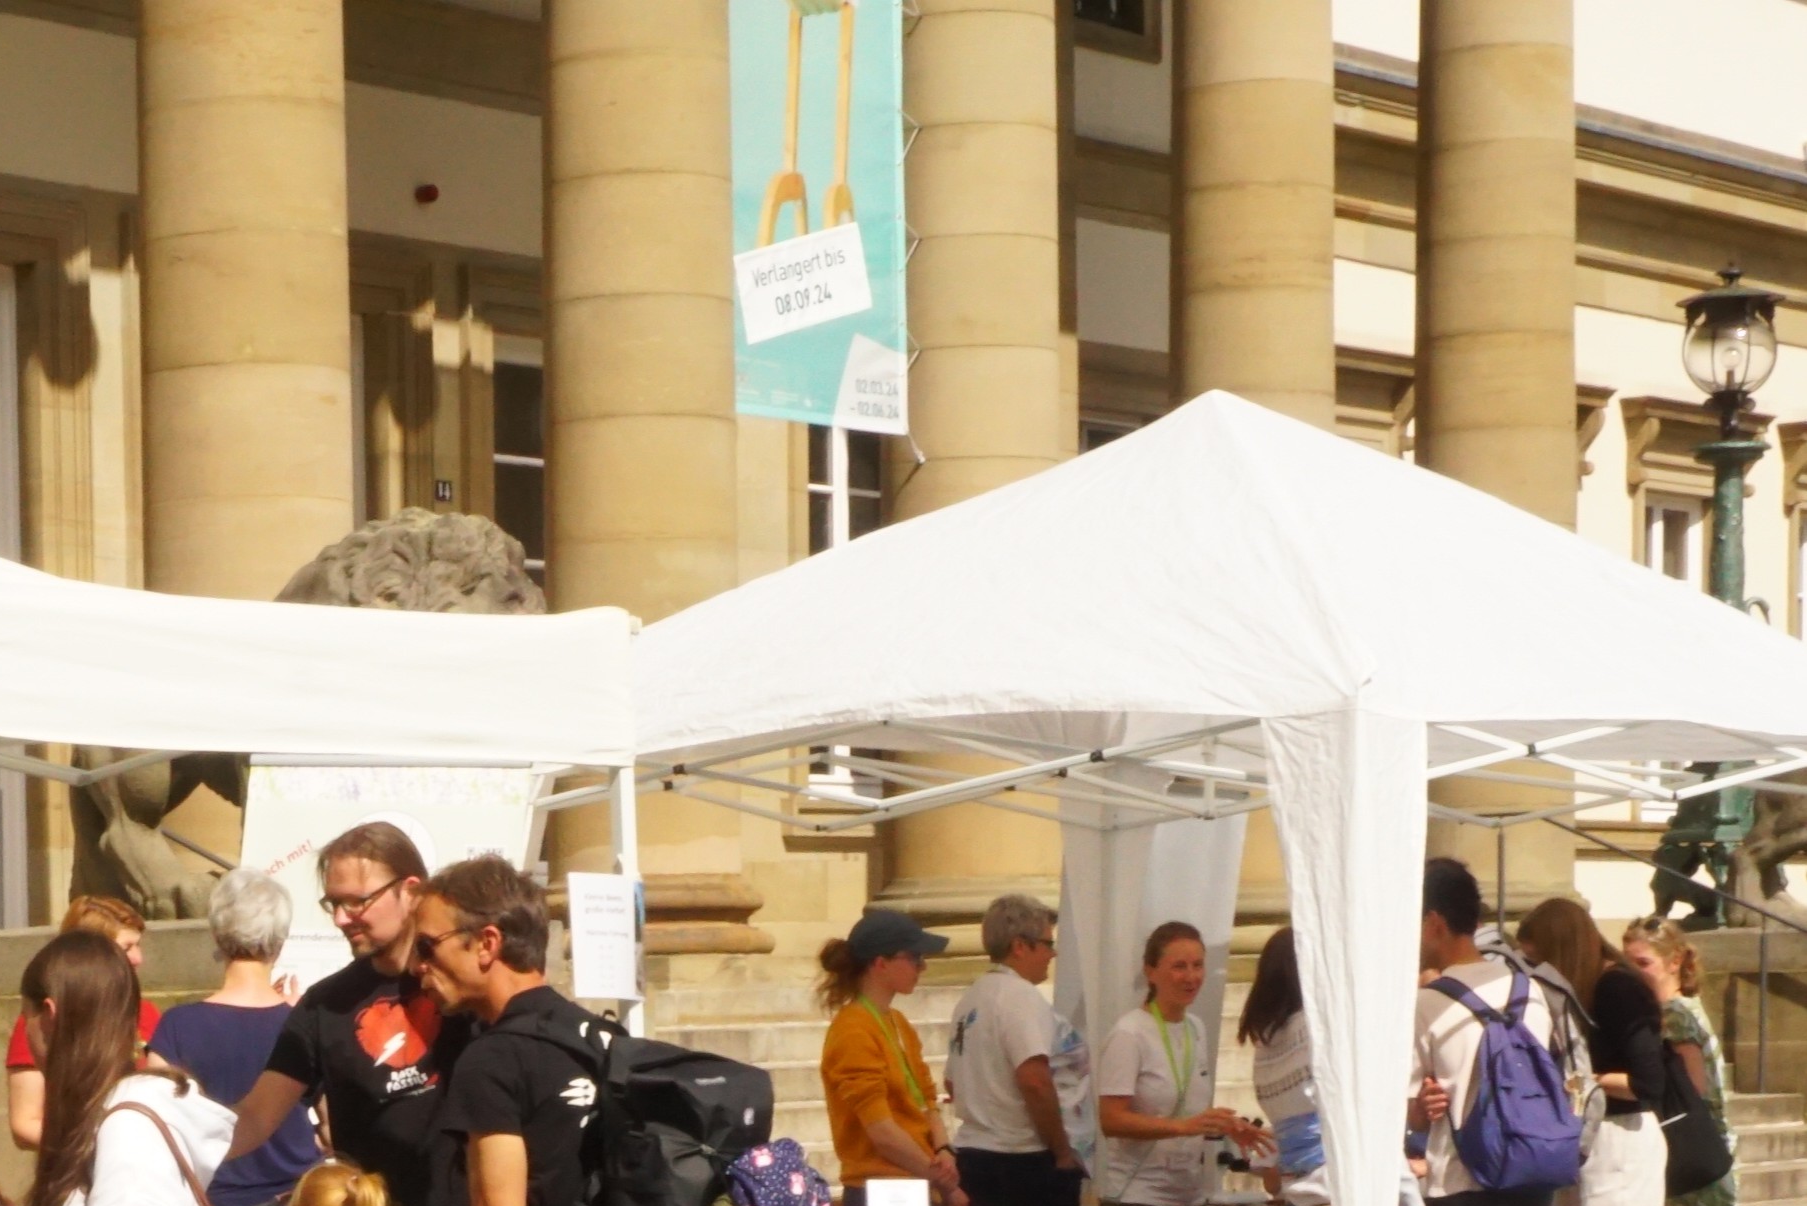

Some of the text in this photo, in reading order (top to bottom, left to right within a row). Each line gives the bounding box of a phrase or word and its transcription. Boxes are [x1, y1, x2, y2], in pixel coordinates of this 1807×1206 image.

[824, 247, 846, 269] bis
[775, 282, 833, 316] 08.09.24
[286, 838, 314, 863] mit!
